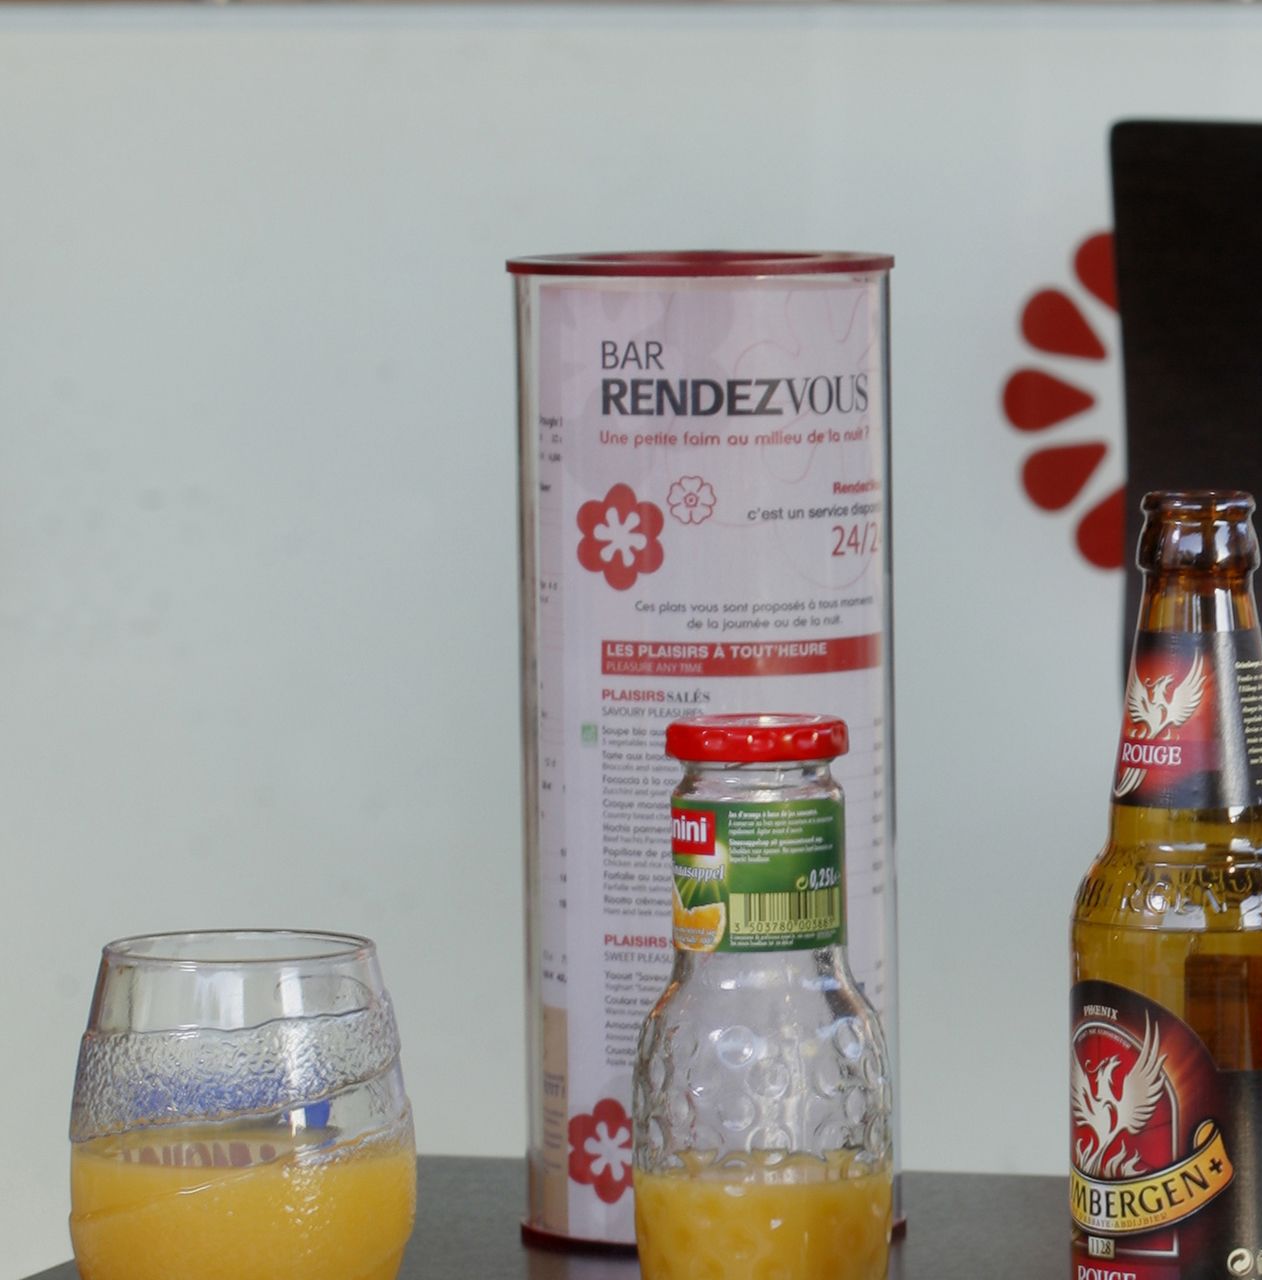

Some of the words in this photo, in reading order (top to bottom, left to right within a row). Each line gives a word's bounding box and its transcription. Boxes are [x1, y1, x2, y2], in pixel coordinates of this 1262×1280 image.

[601, 340, 665, 370] BAR
[600, 430, 628, 445] Une
[634, 429, 678, 448] petite
[684, 429, 721, 445] faim
[727, 433, 749, 446] au
[755, 429, 803, 445] milieu
[807, 427, 825, 443] de
[828, 427, 841, 442] la
[747, 507, 784, 520] c'est
[788, 508, 805, 519] un
[808, 503, 849, 519] service
[635, 600, 654, 613] Ces
[659, 601, 687, 615] plats
[690, 602, 719, 614] vous
[723, 600, 748, 613] sont
[752, 599, 805, 615] proposés
[687, 618, 704, 630] de
[707, 618, 719, 630] la
[721, 617, 770, 633] journée
[774, 618, 790, 629] ou
[793, 616, 808, 628] de
[810, 615, 821, 627] la
[606, 643, 635, 658] LES
[638, 643, 709, 659] PLAISIRS
[730, 641, 828, 659] TOUT'HEURE
[606, 661, 655, 673] PLEASURE
[656, 662, 678, 673] ANY
[679, 662, 704, 673] TIME
[602, 689, 665, 702] PLAISIRS
[602, 706, 645, 717] SAVOURY
[1121, 742, 1182, 766] ROUGE
[604, 934, 667, 948] PLAISIRS
[604, 951, 635, 961] SWEET
[1089, 1238, 1112, 1256] 1128
